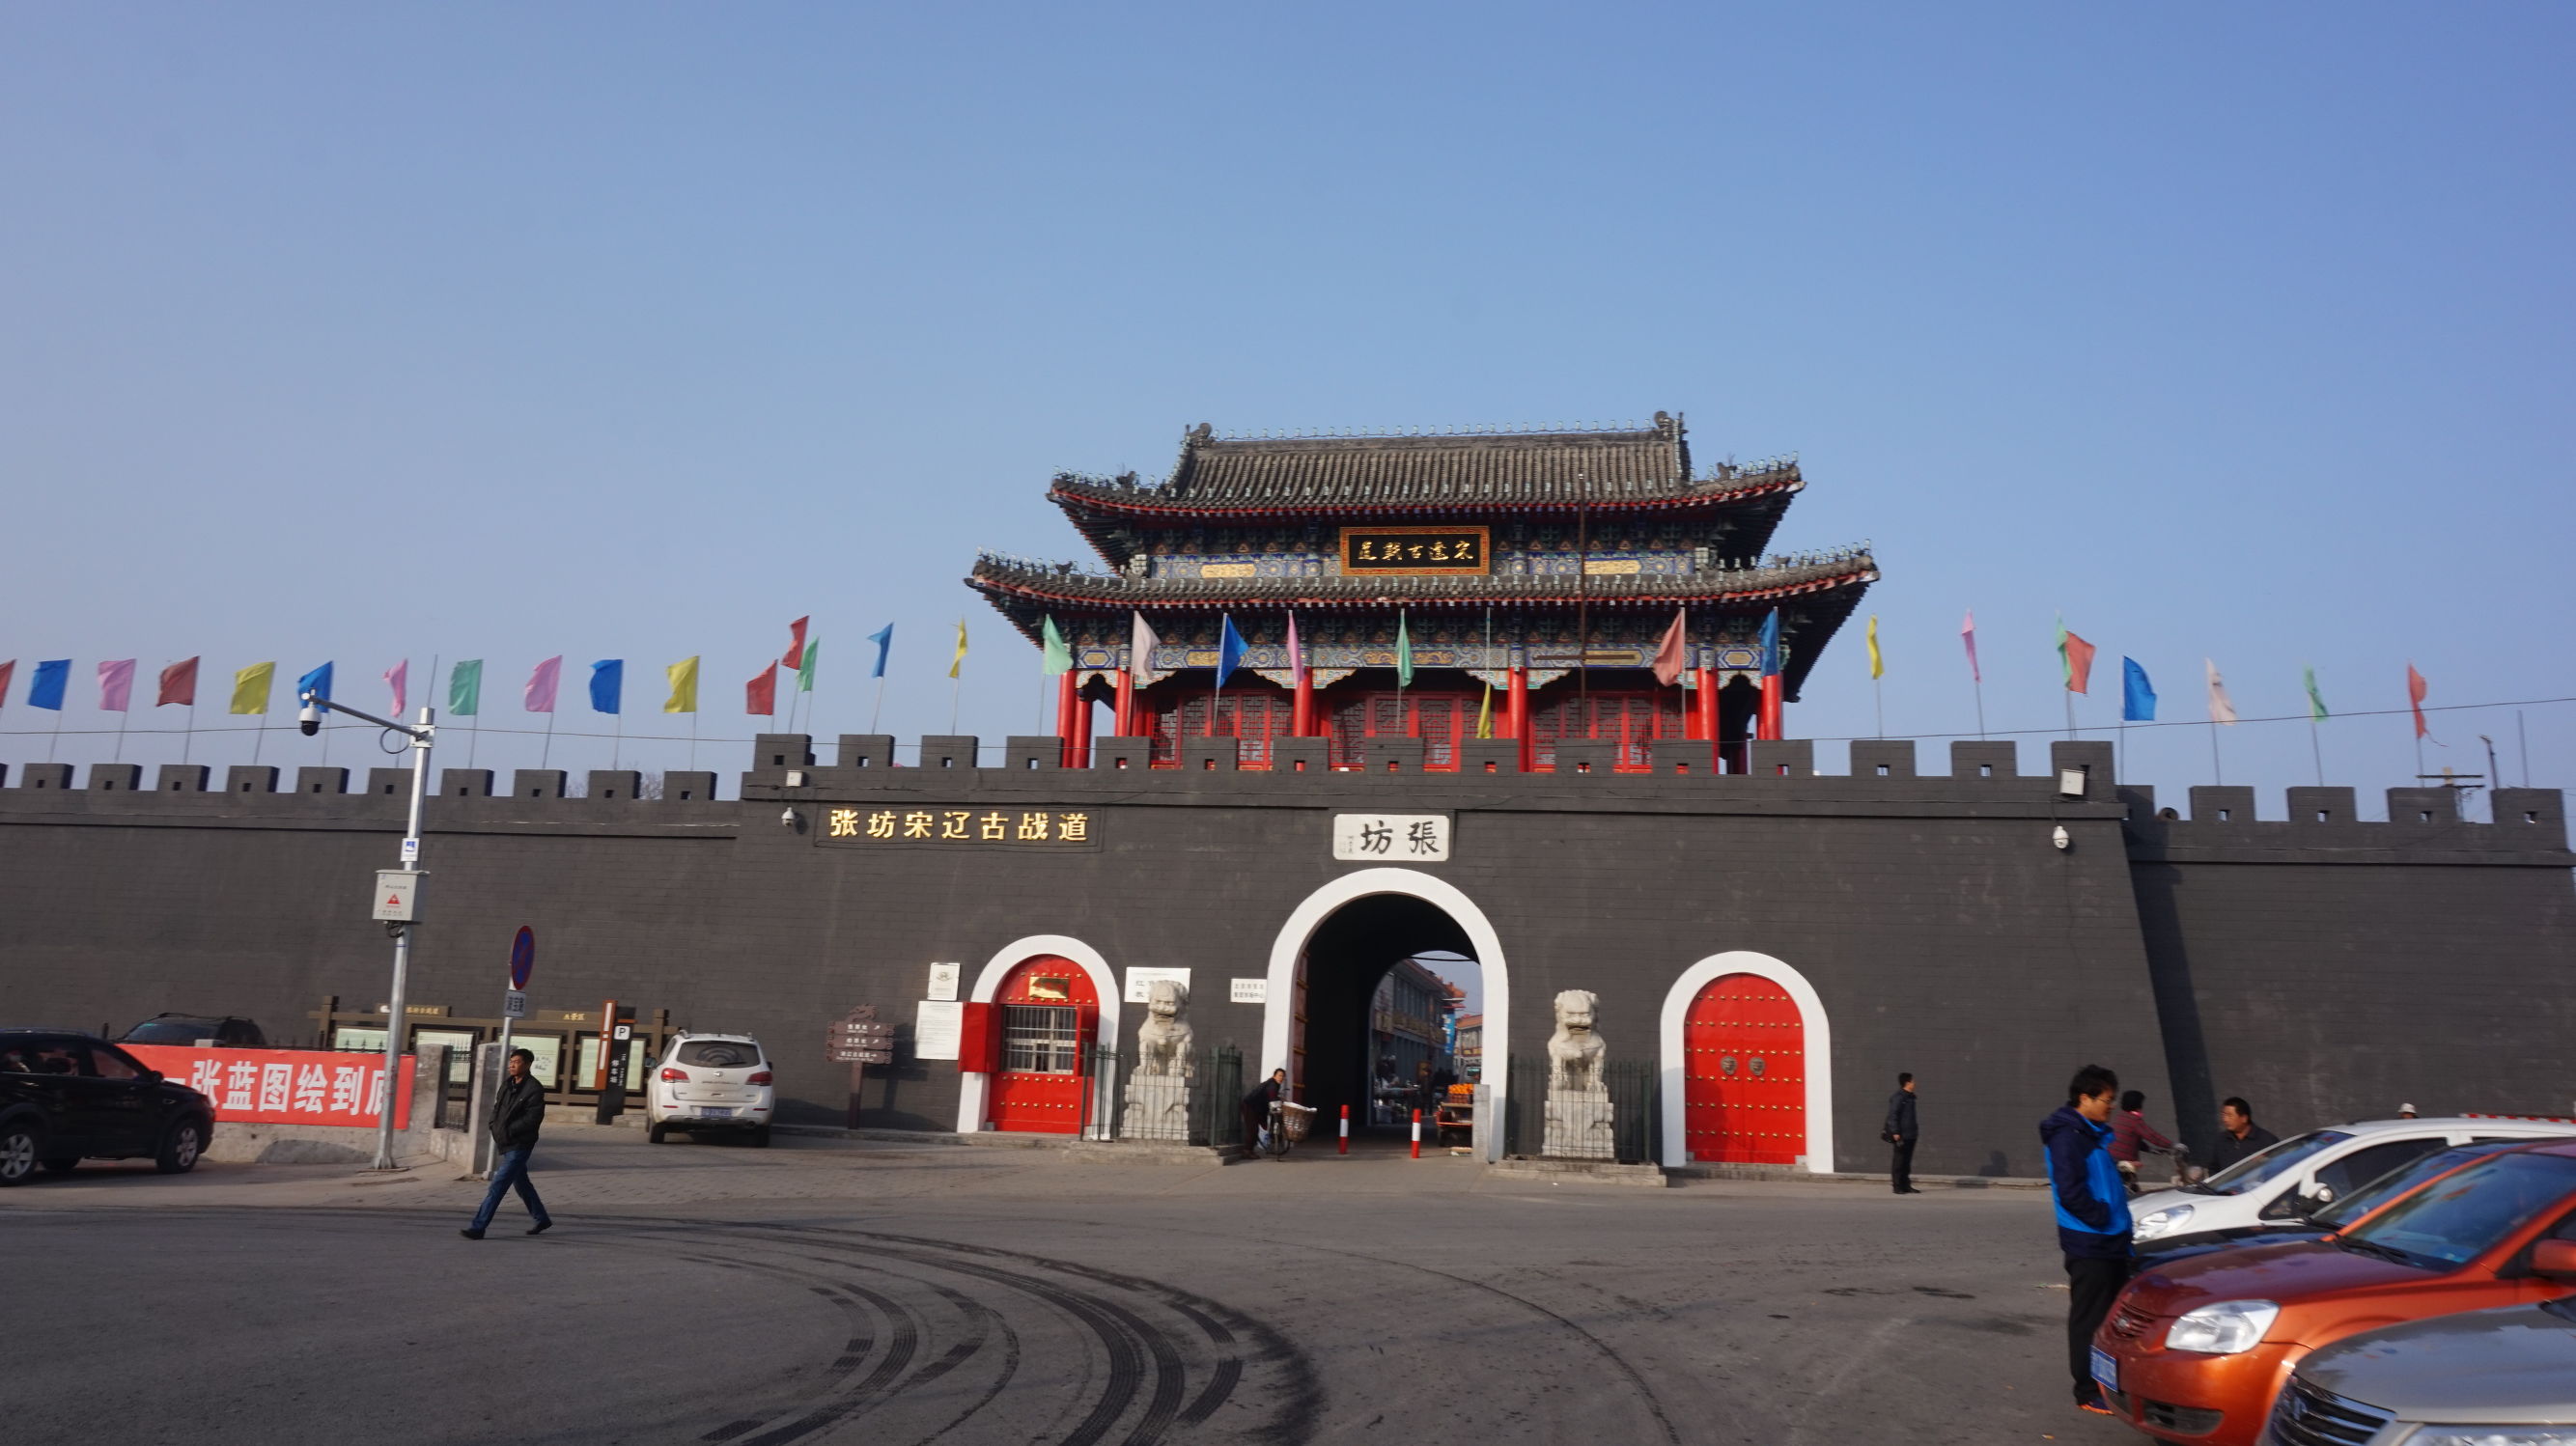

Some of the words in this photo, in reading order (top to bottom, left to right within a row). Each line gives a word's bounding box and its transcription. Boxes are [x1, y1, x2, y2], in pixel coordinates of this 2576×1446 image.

[830, 809, 1089, 842] 张坊宋辽古战道
[1360, 820, 1440, 855] 張坊
[619, 1027, 627, 1037] P
